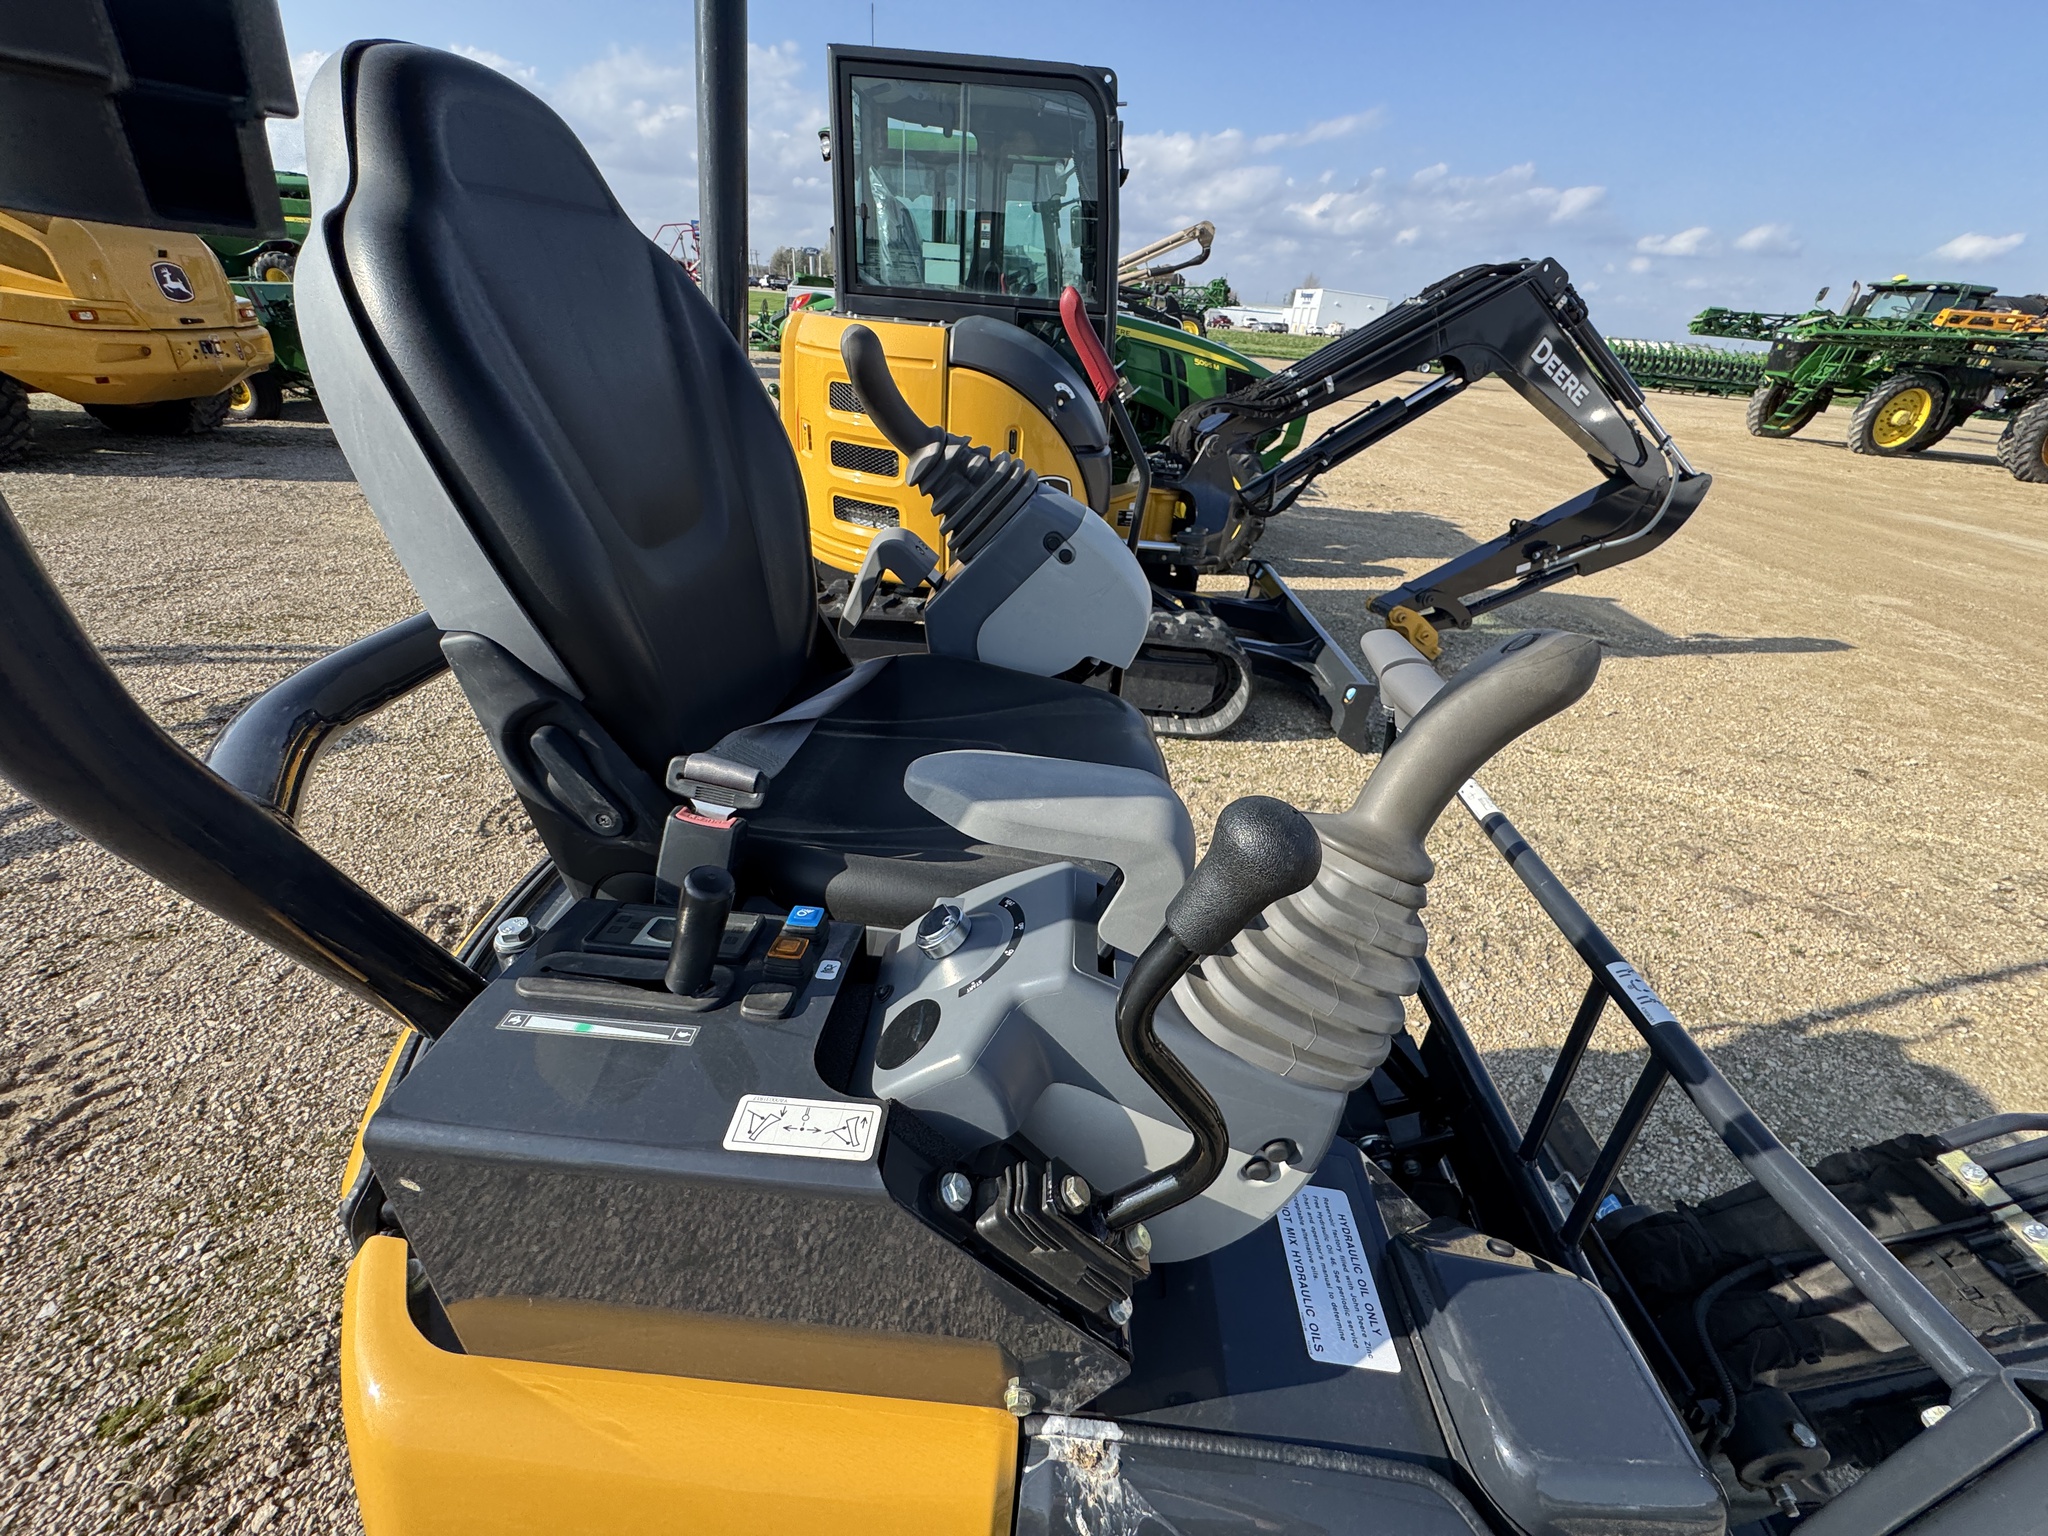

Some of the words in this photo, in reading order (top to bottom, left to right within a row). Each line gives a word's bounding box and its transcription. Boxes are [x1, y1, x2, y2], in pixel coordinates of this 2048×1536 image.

[1531, 337, 1590, 407] DEERE
[967, 979, 982, 994] START
[1286, 1226, 1298, 1246] MIX
[1294, 1196, 1304, 1226] cceptable
[1301, 1227, 1314, 1264] alternative
[1310, 1266, 1318, 1281] oils.
[1302, 1193, 1311, 1213] chart
[1307, 1211, 1315, 1224] and
[1311, 1226, 1324, 1260] operator's
[1320, 1262, 1333, 1289] manual
[1328, 1291, 1334, 1300] to
[1331, 1302, 1345, 1341] determine
[1312, 1195, 1320, 1209] Free
[1317, 1211, 1329, 1242] Hydraulic
[1326, 1244, 1334, 1255] Oil
[1336, 1285, 1350, 1317] periodic
[1347, 1320, 1359, 1349] service
[1338, 1213, 1363, 1274] HYDRAULIC
[1357, 1279, 1369, 1298] OIL
[1364, 1302, 1382, 1336] ONLY
[1291, 1249, 1316, 1317] HYDRAULIC
[1323, 1196, 1335, 1228] Reservoir
[1332, 1229, 1342, 1252] factory
[1340, 1255, 1350, 1273] filled
[1345, 1275, 1354, 1290] with
[1350, 1293, 1360, 1312] John
[1357, 1315, 1367, 1338] Deere
[1364, 1341, 1373, 1359] Zinc
[1309, 1322, 1324, 1352] OILS
